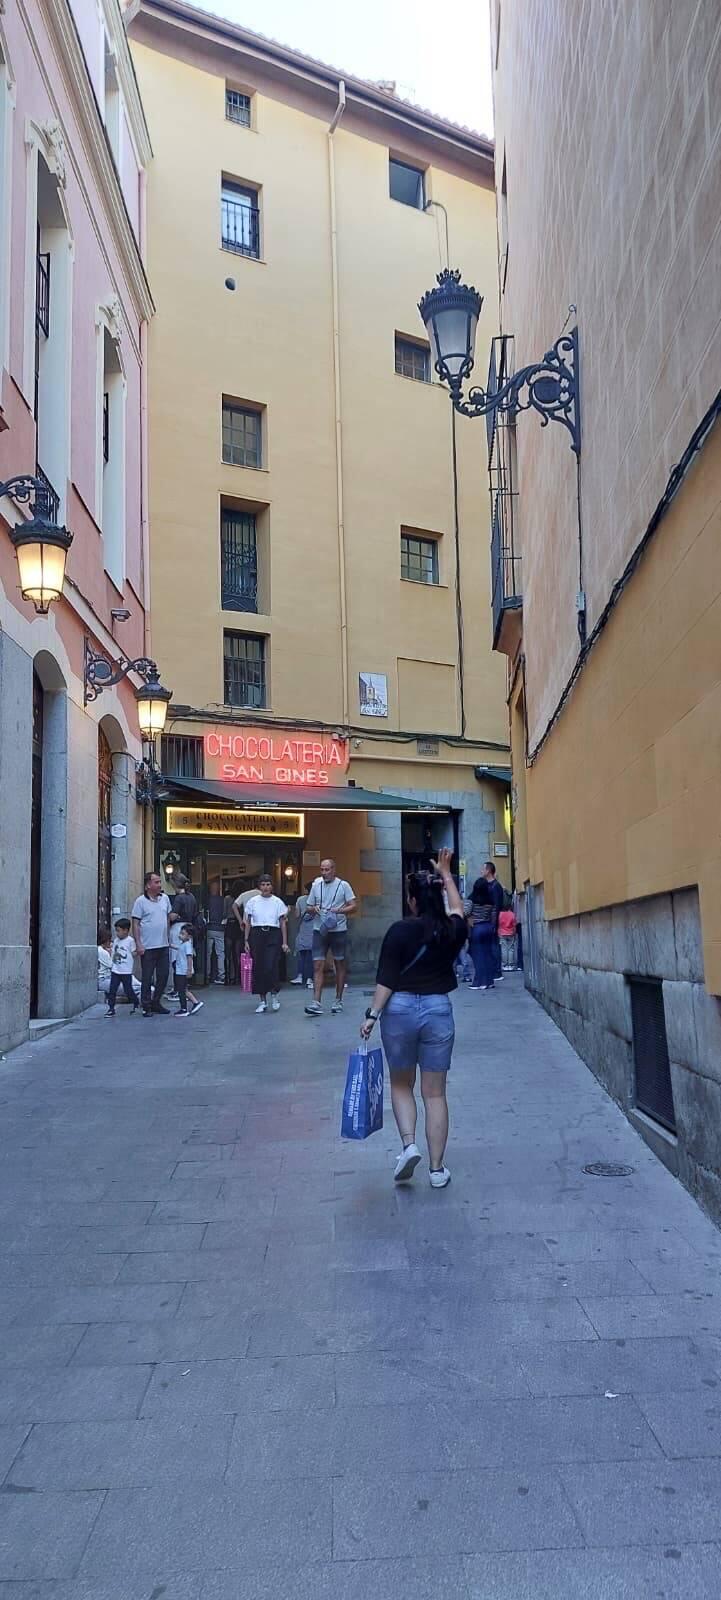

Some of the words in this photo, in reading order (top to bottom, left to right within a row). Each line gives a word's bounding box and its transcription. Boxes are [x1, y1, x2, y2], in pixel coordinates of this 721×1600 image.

[206, 733, 342, 765] CHOCOLATERIA
[223, 764, 264, 781] SAN
[276, 767, 329, 784] GINES
[196, 812, 277, 823] CHOCOLATERIA
[208, 823, 228, 831] SAN
